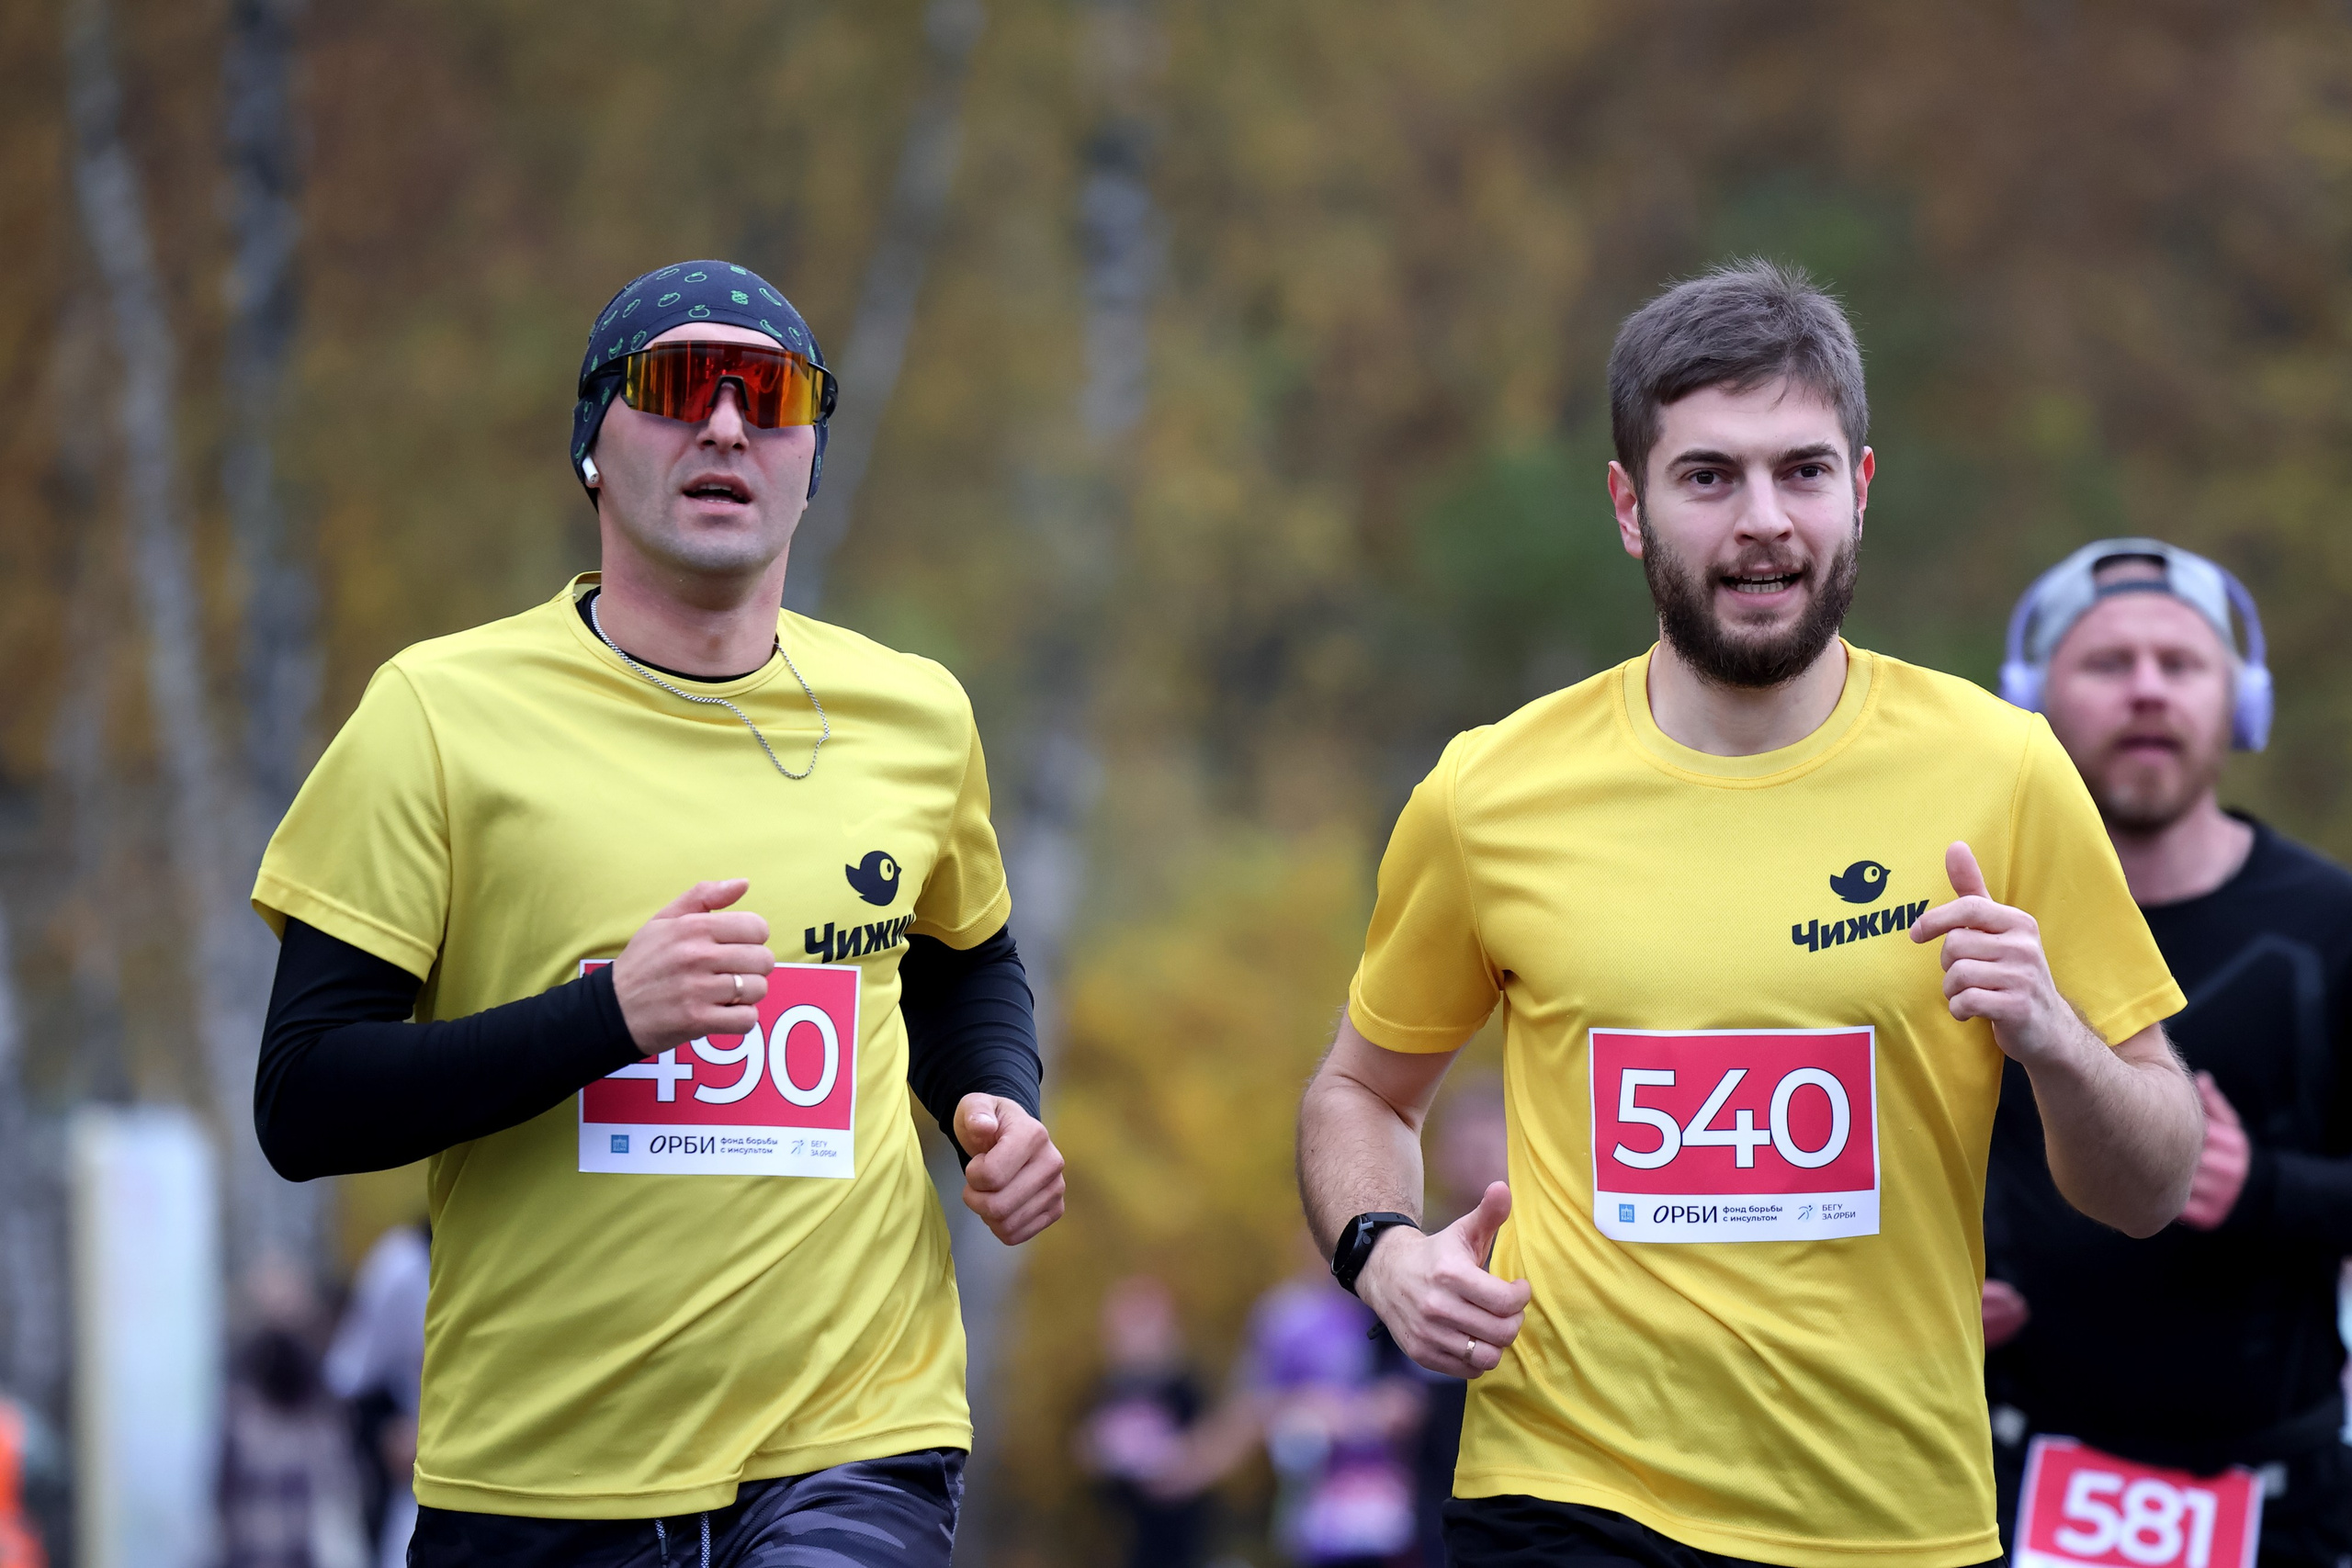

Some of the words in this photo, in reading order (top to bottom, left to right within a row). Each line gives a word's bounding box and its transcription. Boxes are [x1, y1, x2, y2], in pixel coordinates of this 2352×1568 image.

[1611, 1066, 1850, 1169] 540
[650, 1135, 715, 1154] ОРБИ
[720, 1137, 743, 1145] фонд
[746, 1137, 778, 1145] борьбы
[1653, 1205, 1717, 1224] ОРБИ
[1723, 1205, 1747, 1213] фонд
[1748, 1205, 1782, 1213] борьбы
[1822, 1203, 1843, 1212] БЕГУ
[1833, 1212, 1856, 1220] ОРБИ
[2054, 1469, 2218, 1568] 581
